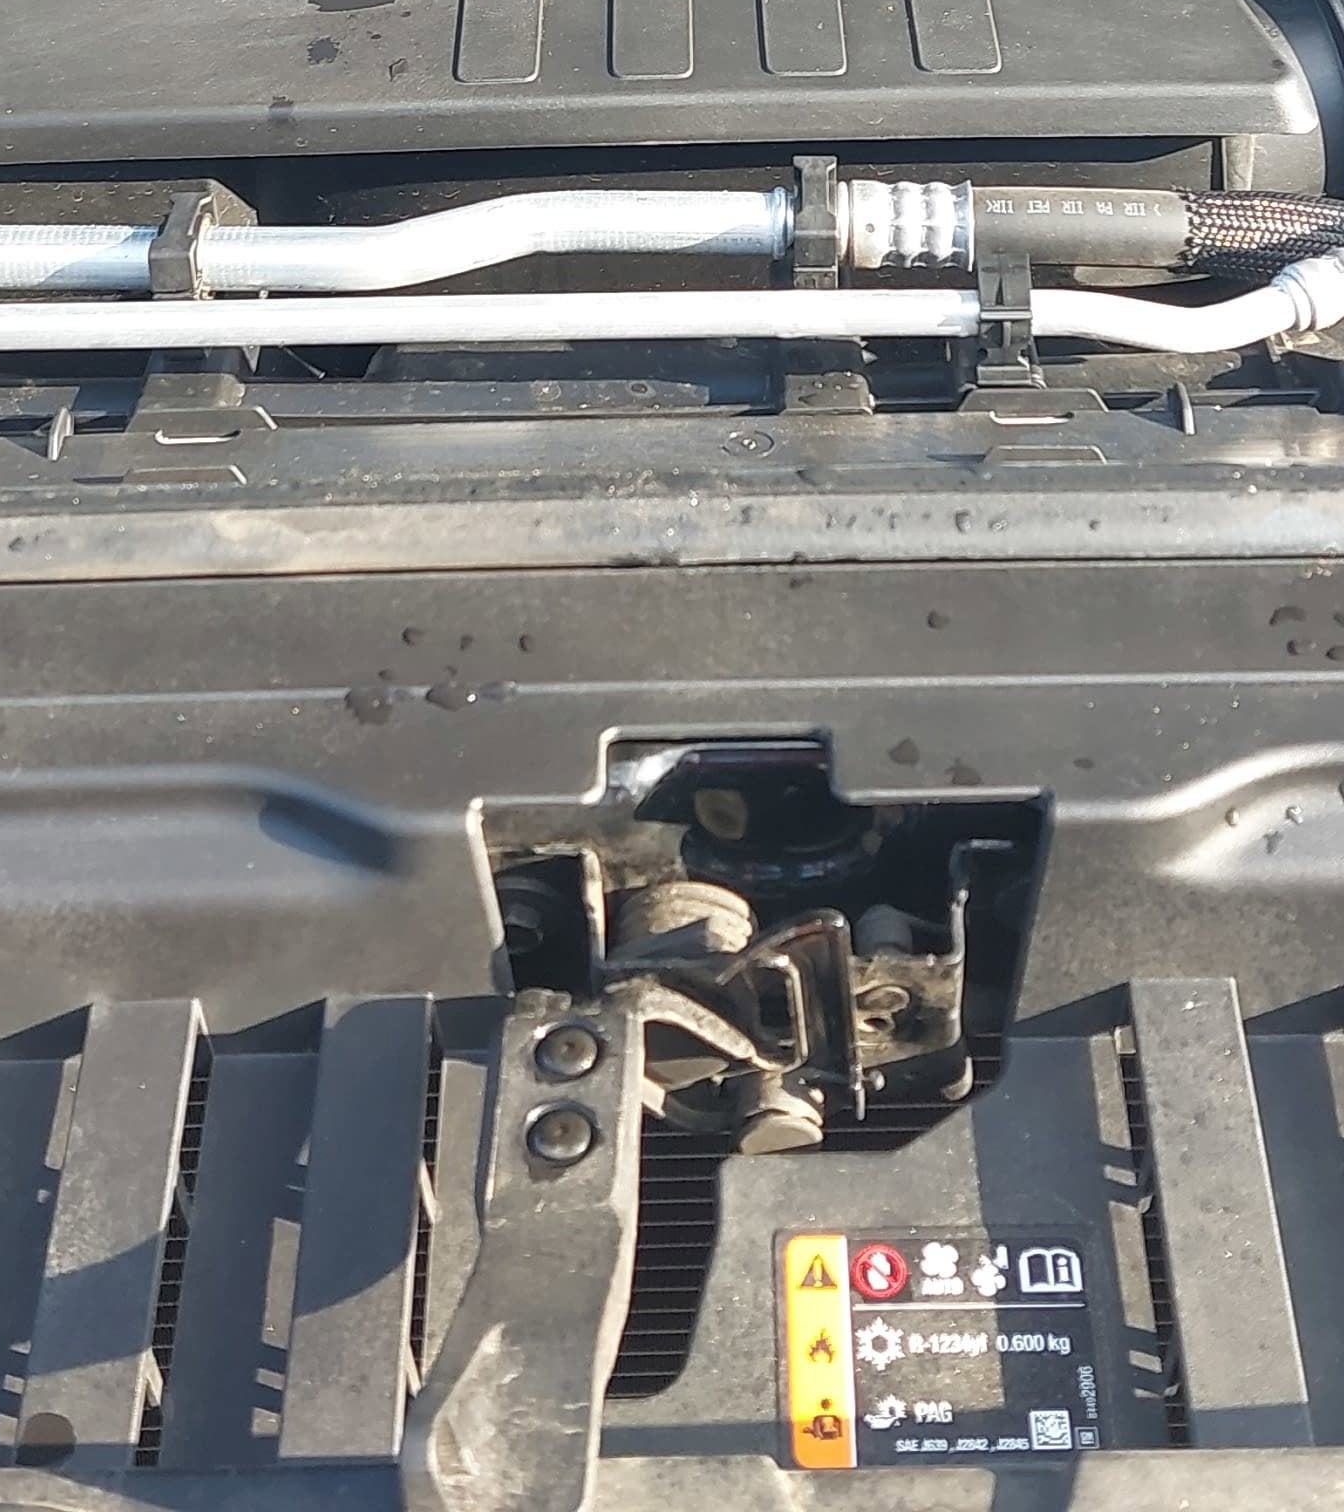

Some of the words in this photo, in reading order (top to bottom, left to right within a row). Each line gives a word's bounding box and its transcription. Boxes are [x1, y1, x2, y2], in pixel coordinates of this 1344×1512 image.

[1026, 199, 1051, 215] PET
[1096, 201, 1114, 216] PA
[995, 1334, 1045, 1353] 0.600
[1048, 1333, 1071, 1355] kg
[912, 1401, 953, 1424] PAG
[895, 1439, 920, 1452] SAE
